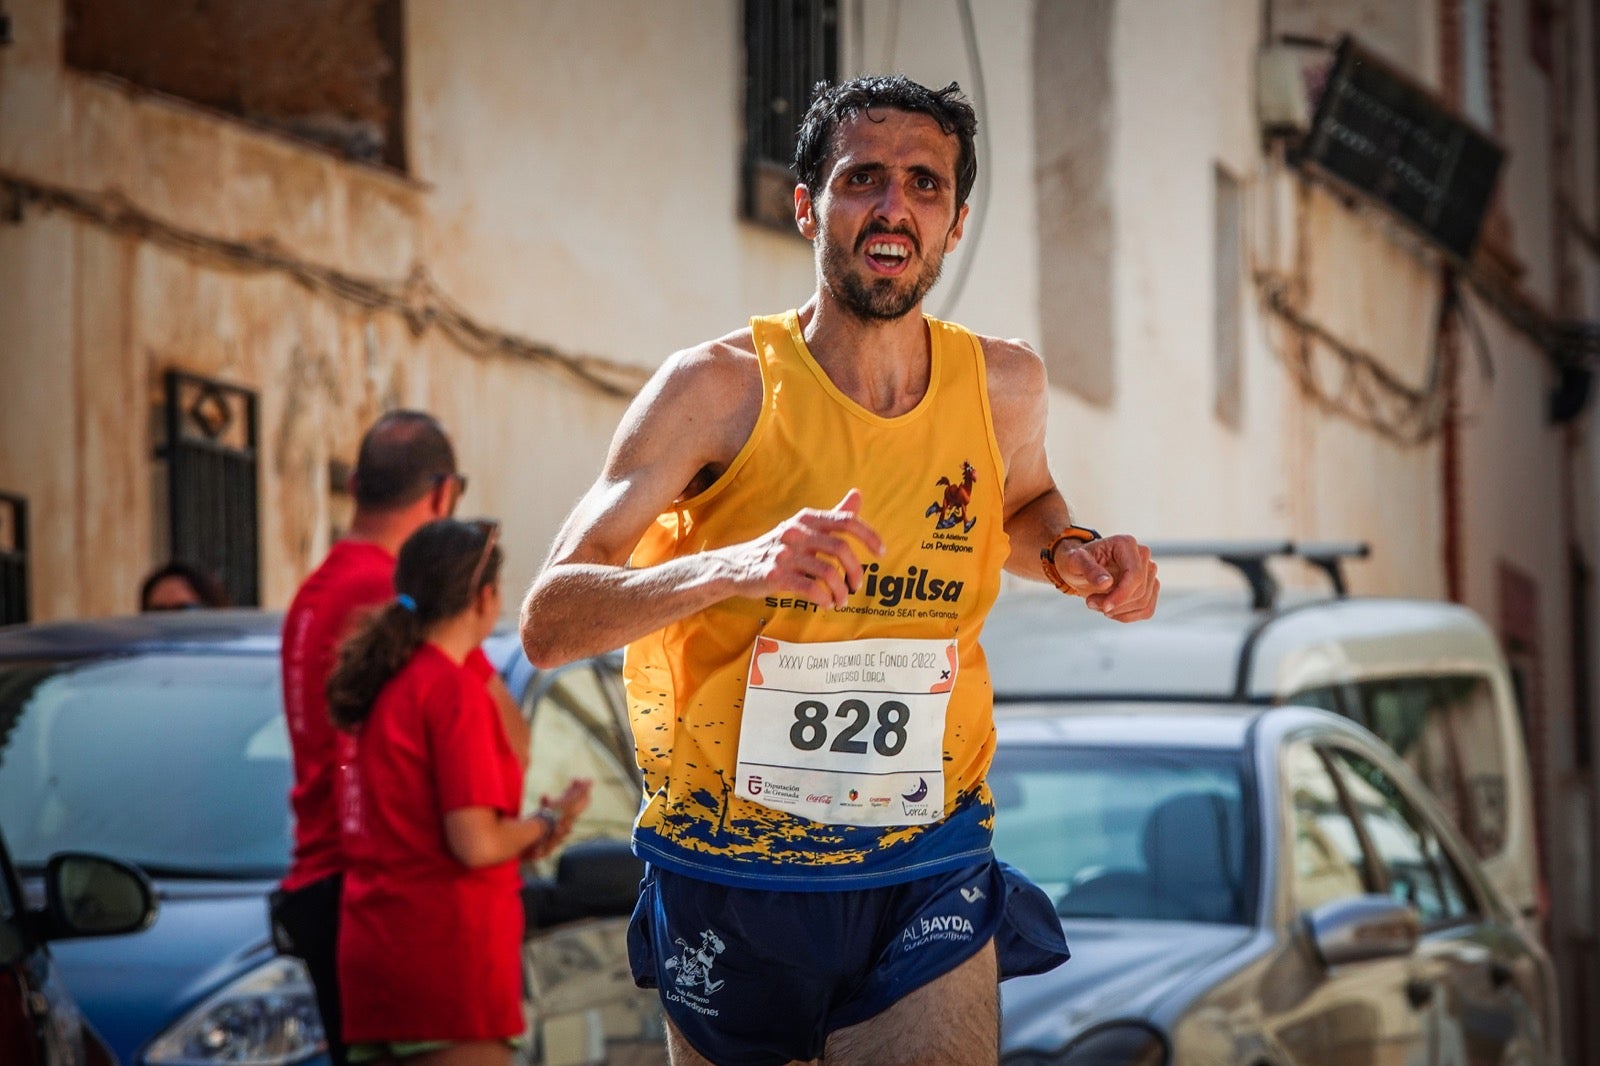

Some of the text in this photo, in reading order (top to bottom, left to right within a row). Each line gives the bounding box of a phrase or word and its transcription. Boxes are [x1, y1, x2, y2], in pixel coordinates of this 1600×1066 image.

[921, 541, 973, 553] Los Perdigones
[765, 596, 820, 613] SEAT
[834, 604, 895, 617] Concesionario
[897, 609, 916, 618] SEAT
[778, 653, 804, 670] XXXV
[911, 653, 936, 668] 2022
[790, 699, 910, 756] 828
[764, 781, 800, 792] Diputación
[772, 790, 799, 798] Granada
[901, 801, 928, 816] Lorca
[666, 990, 680, 1002] Los
